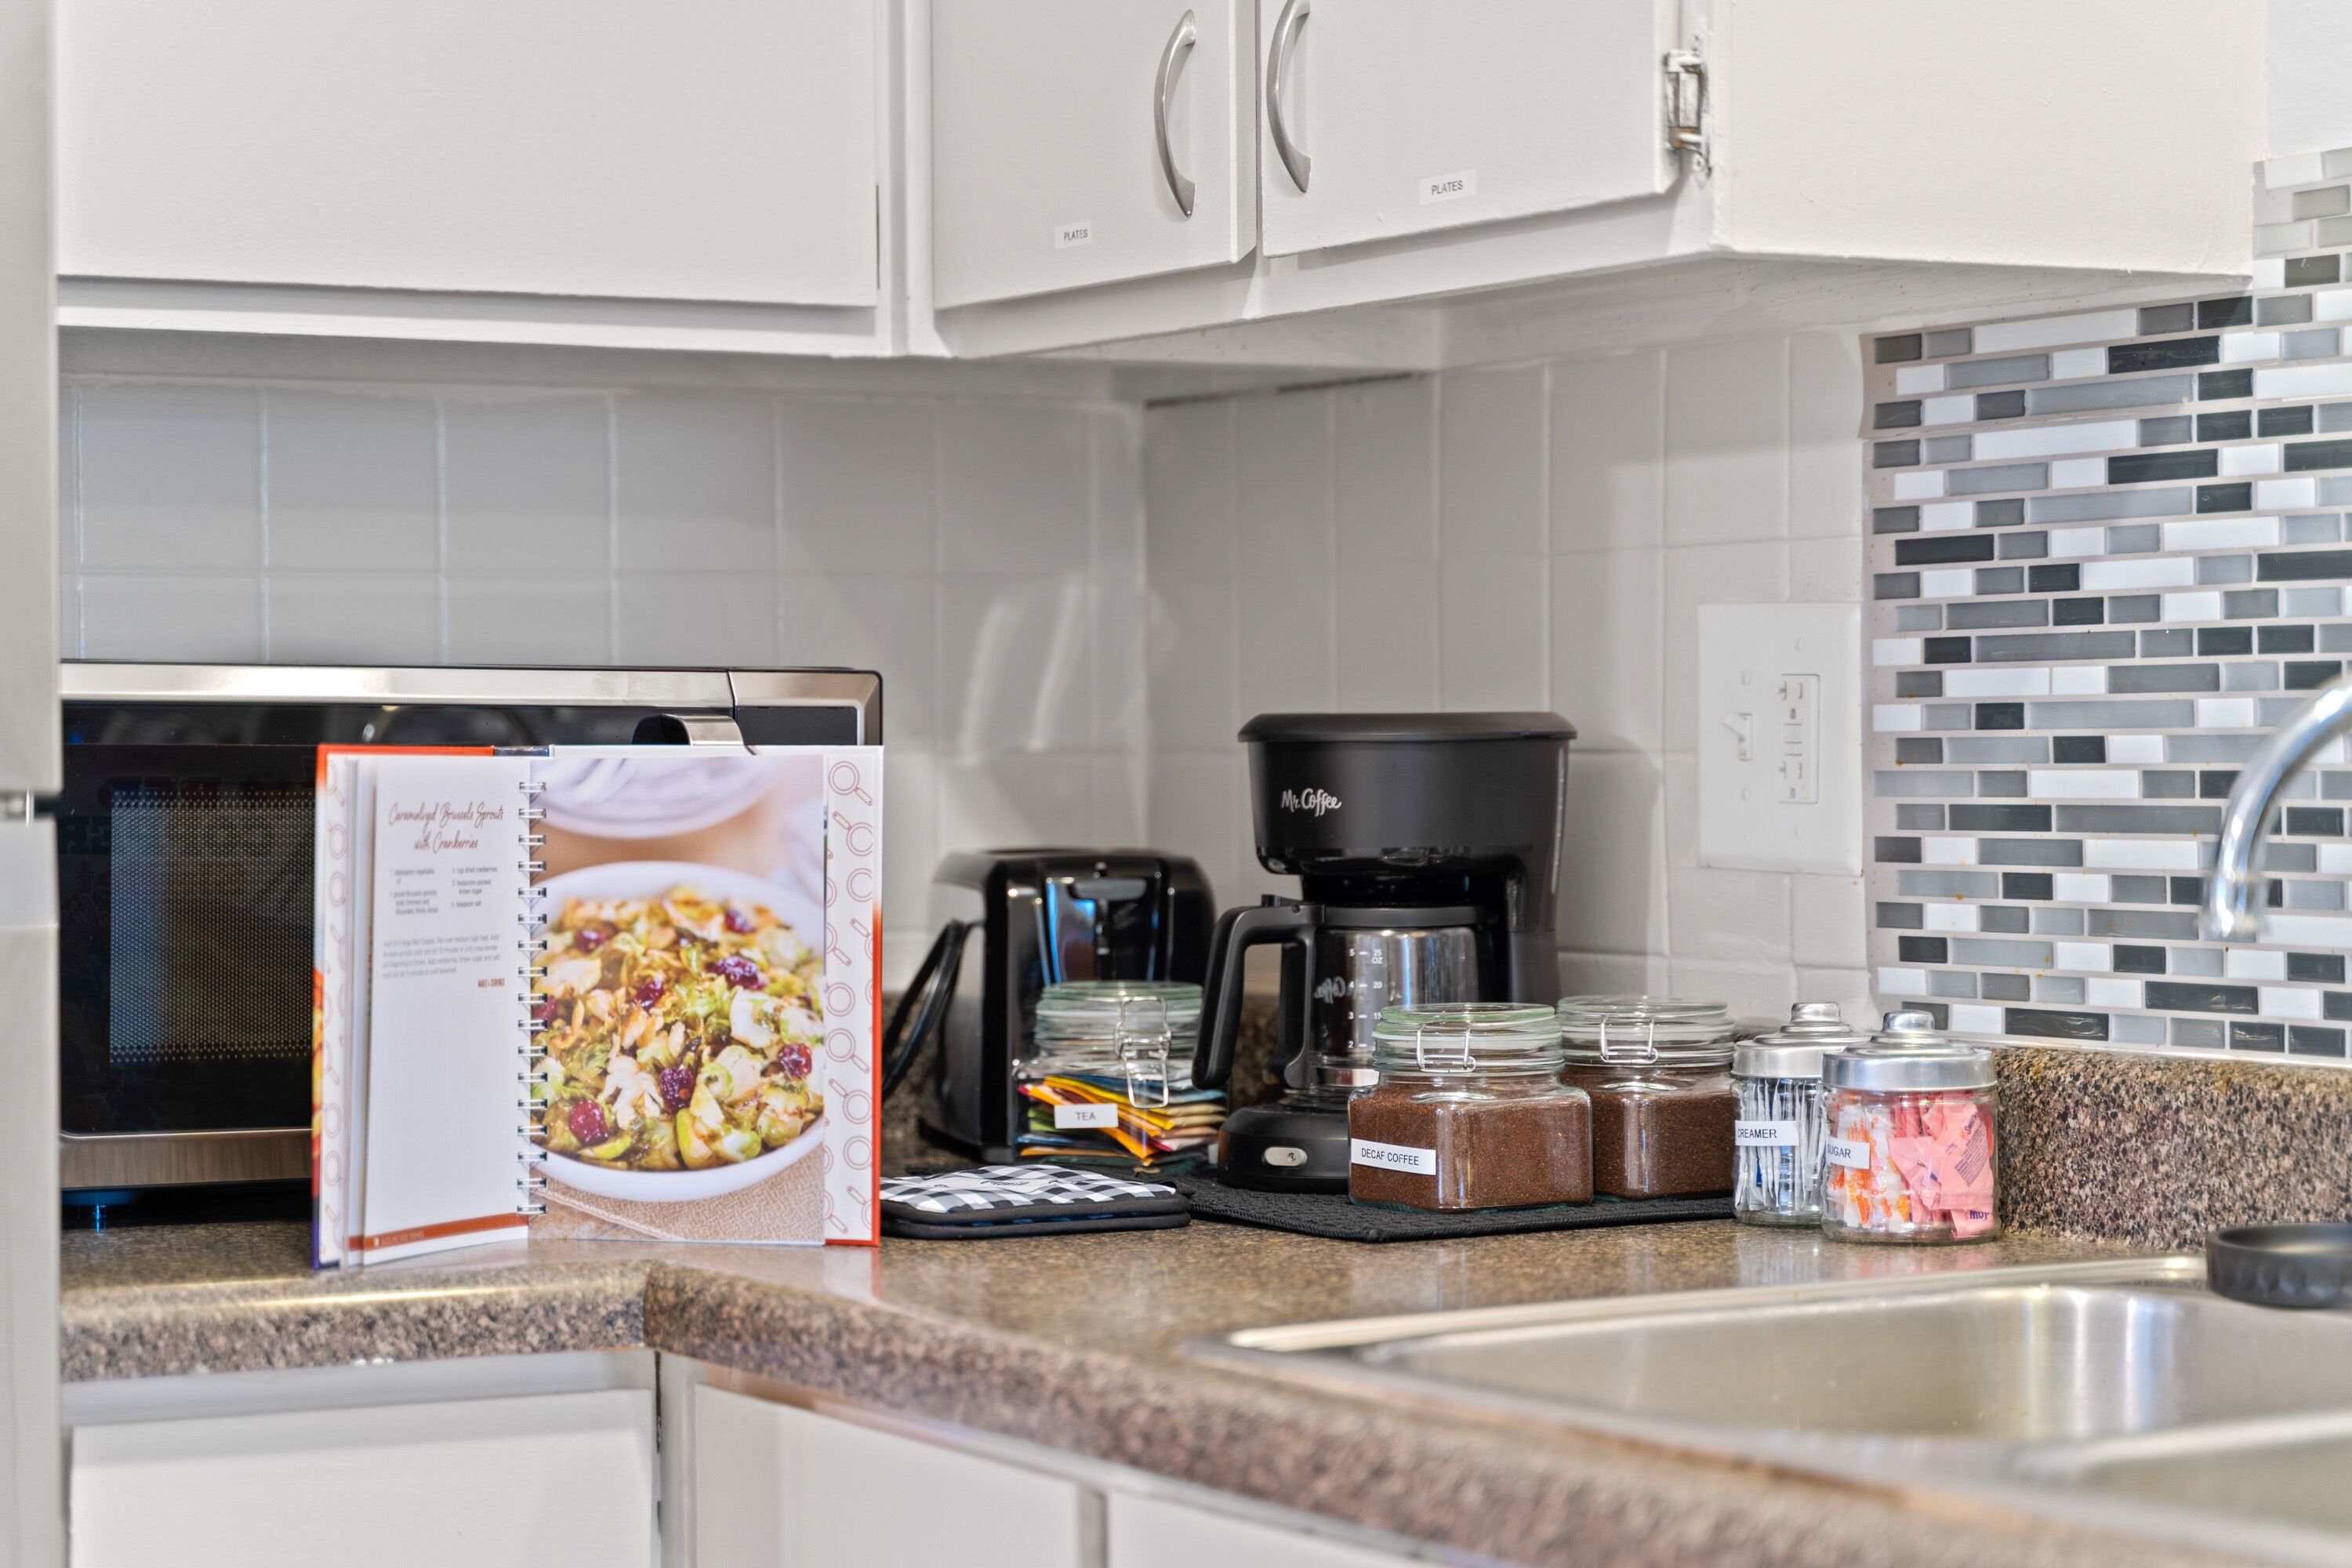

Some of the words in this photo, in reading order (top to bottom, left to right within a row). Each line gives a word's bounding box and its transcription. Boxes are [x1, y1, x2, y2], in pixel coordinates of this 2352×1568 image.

[1431, 180, 1465, 196] PLATES
[1063, 227, 1089, 242] PLATES
[1280, 789, 1301, 812] Mr.
[1301, 787, 1342, 817] Coffee
[439, 801, 474, 828] Brussels
[474, 801, 503, 828] Sprouts
[433, 829, 478, 854] Cranberries
[1348, 1040, 1354, 1049] 2
[1075, 1112, 1097, 1121] TEA
[1737, 1128, 1778, 1139] CREAMER
[1361, 1147, 1385, 1161] DECAF
[1387, 1152, 1420, 1166] COFFEE
[1827, 1143, 1852, 1159] SUGAR
